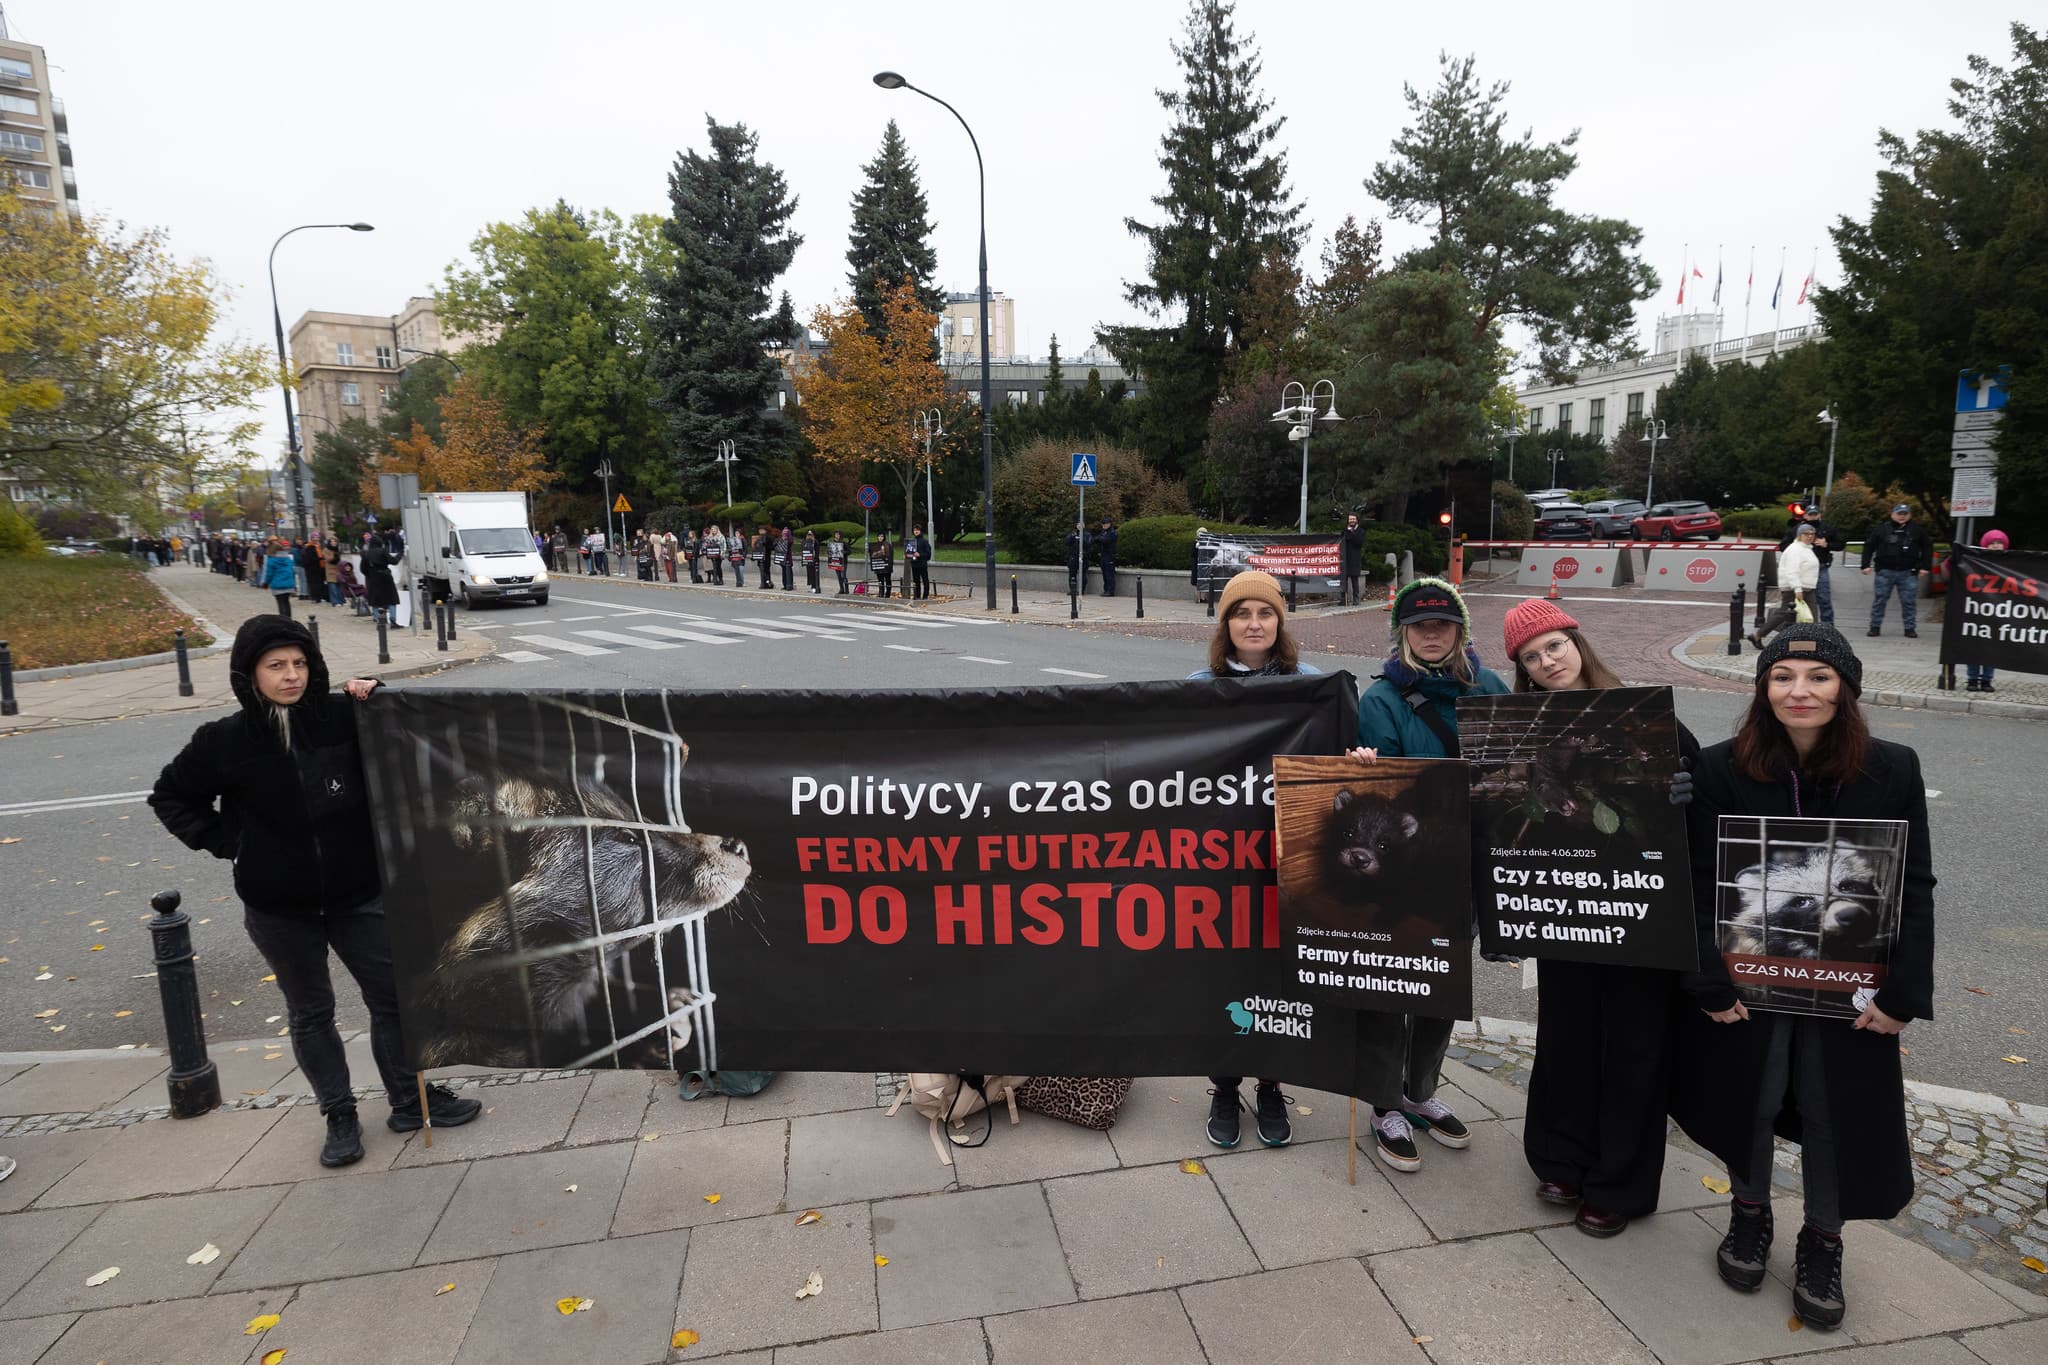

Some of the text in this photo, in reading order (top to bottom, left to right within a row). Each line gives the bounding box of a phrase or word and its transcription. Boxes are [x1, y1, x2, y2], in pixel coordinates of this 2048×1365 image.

[1260, 556, 1291, 564] fermach
[1292, 555, 1338, 564] futrzarskich
[1318, 566, 1338, 574] ruch!
[1555, 564, 1578, 573] STOP
[1687, 566, 1715, 576] STOP
[1965, 573, 2039, 597] CZAS
[1962, 622, 1992, 639] na
[791, 775, 991, 821] Politycy,
[1008, 779, 1112, 813] czas
[796, 836, 961, 873] FERMY
[1490, 847, 1521, 857] Zdjęcie
[1529, 848, 1550, 857] dnia:
[1551, 848, 1597, 858] 4.06.2025
[1492, 866, 1665, 891] Czy z tego, jako
[803, 882, 1281, 951] DO HISTORII
[1495, 893, 1650, 921] Polacy, mamy
[1296, 926, 1325, 937] Zdjęcie
[1331, 929, 1351, 938] dnia:
[1351, 931, 1393, 942] 4.06.2025
[1498, 919, 1626, 945] być dumni?
[1297, 944, 1450, 974] Fermy futrzarskie
[1297, 968, 1432, 997] to nie rolnictwo
[1734, 962, 1875, 984] CZAS NA ZAKAZ
[1243, 996, 1314, 1018] otwarte
[1254, 1013, 1313, 1040] klatki
